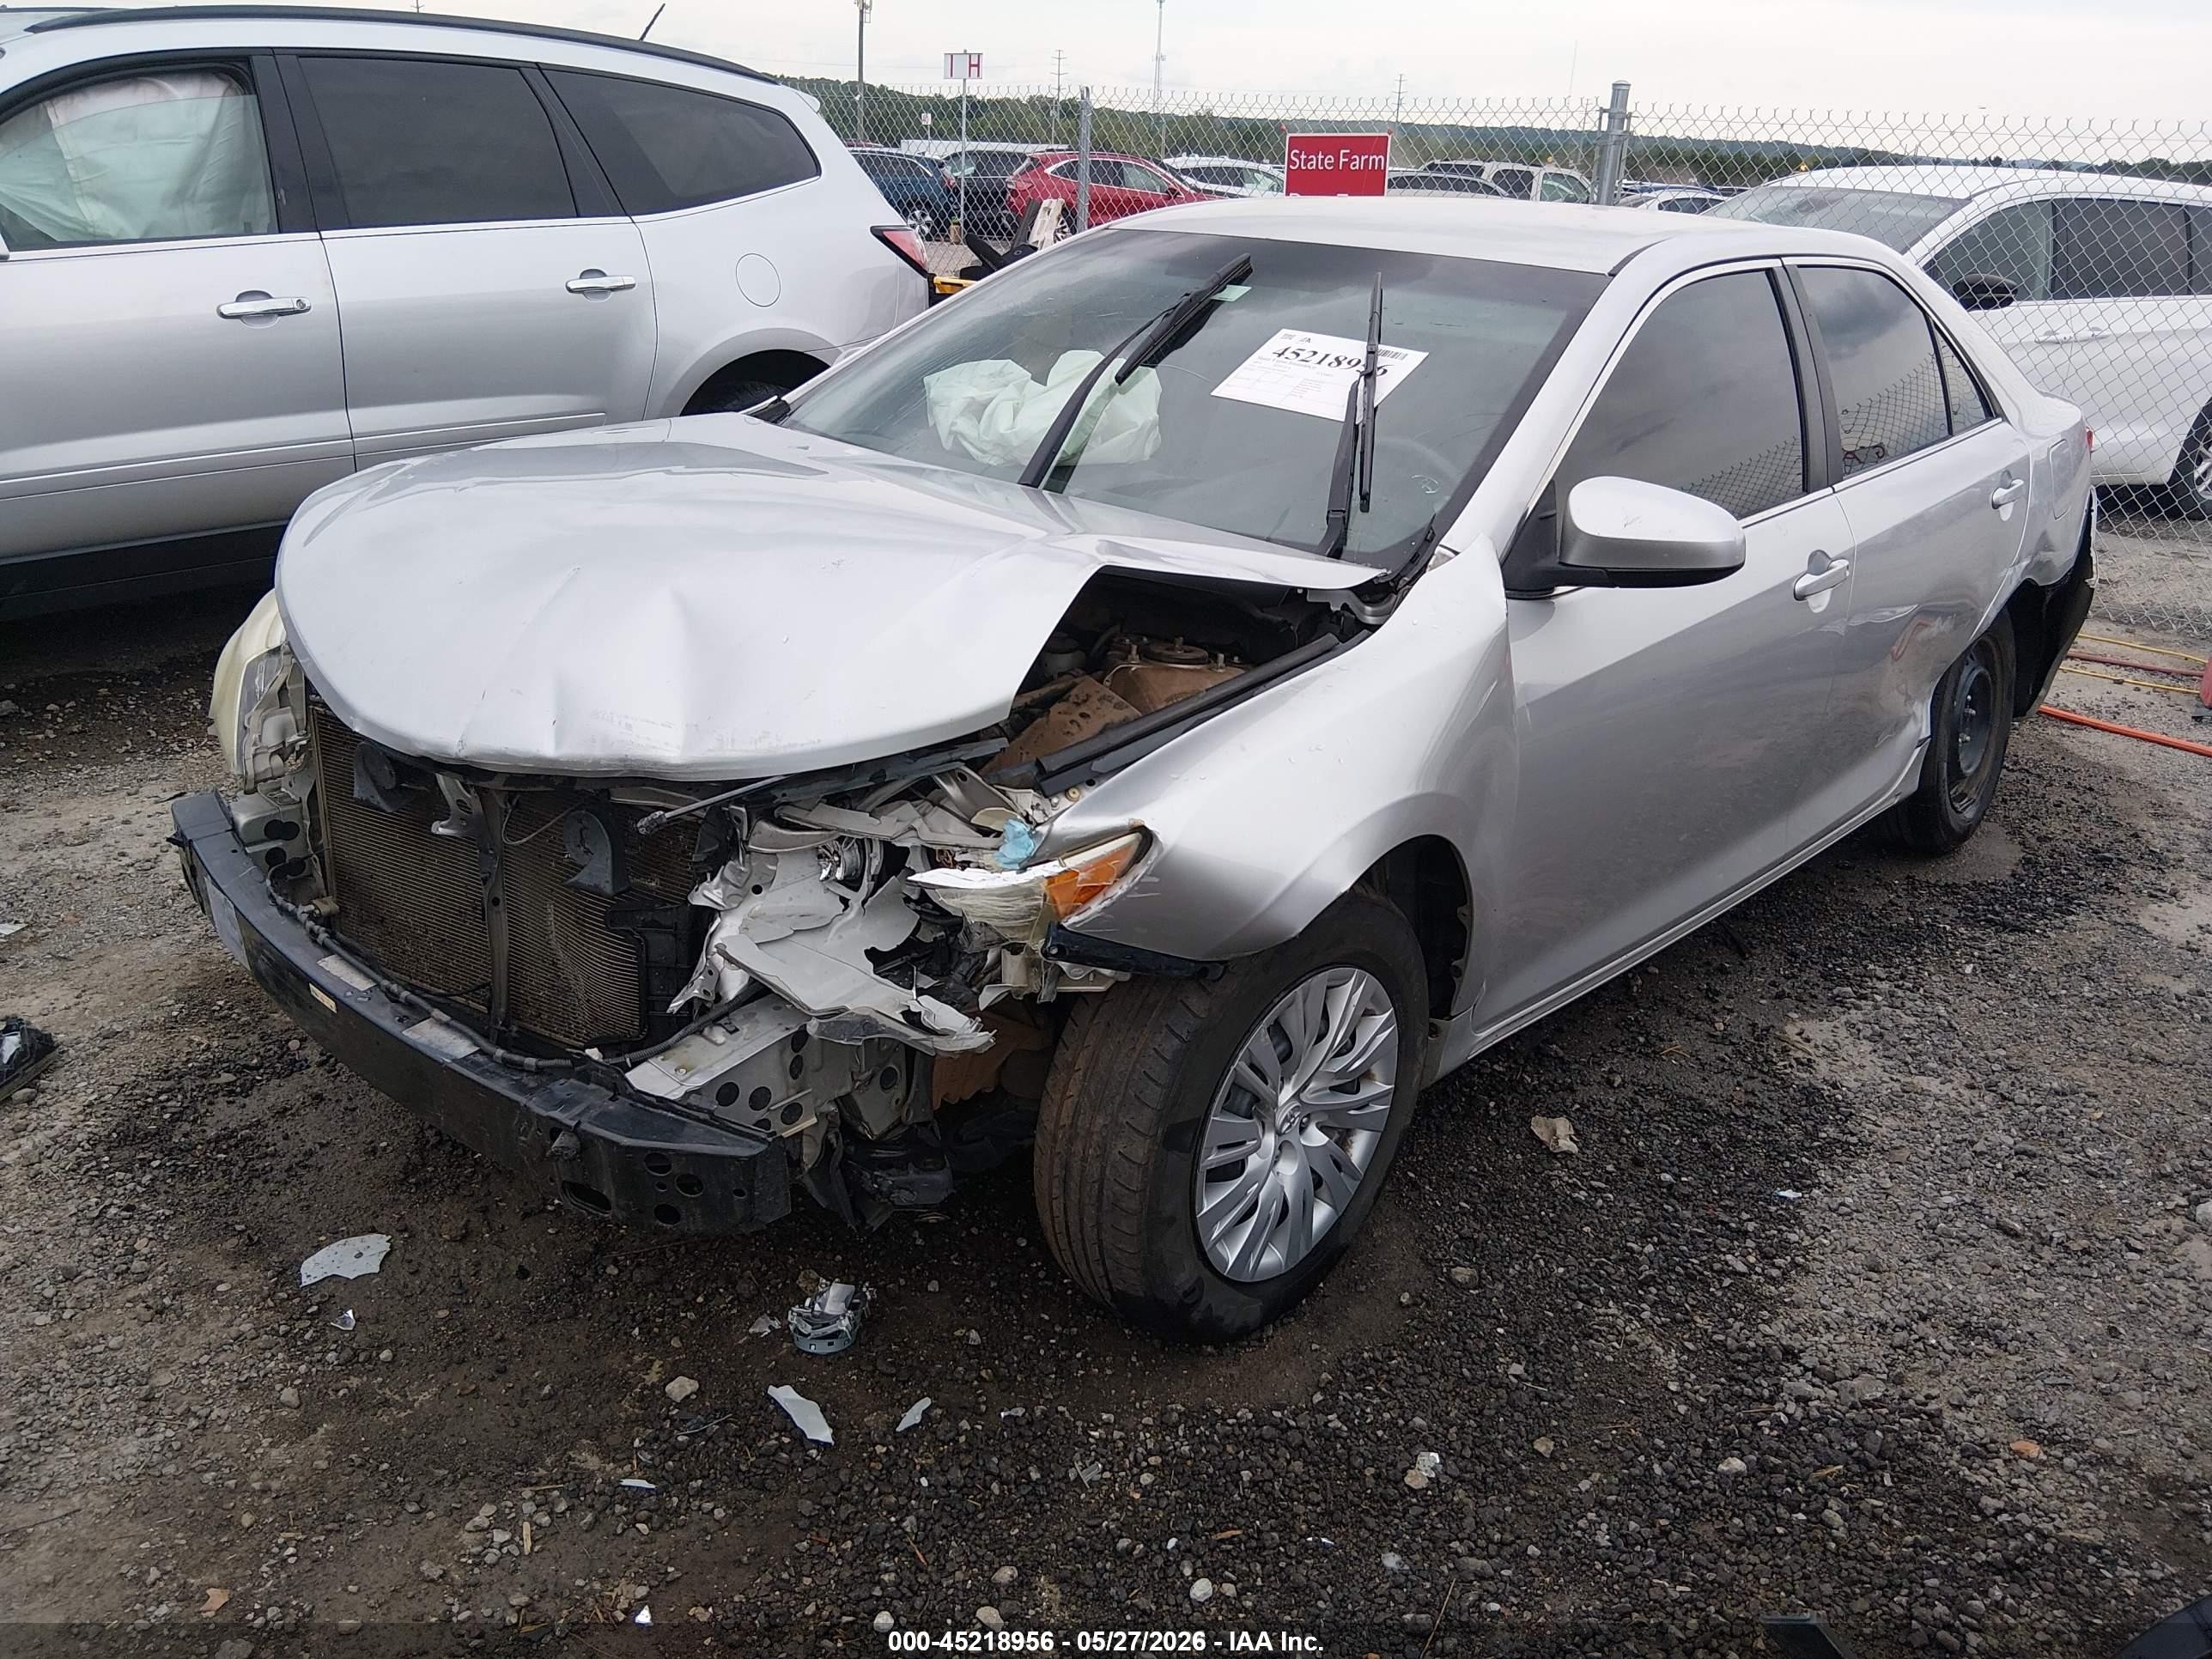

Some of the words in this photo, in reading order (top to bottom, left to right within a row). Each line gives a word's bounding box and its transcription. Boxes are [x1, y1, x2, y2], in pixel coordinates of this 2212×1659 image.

[968, 54, 981, 77] H
[1289, 149, 1334, 170] State
[1339, 149, 1385, 170] Farm
